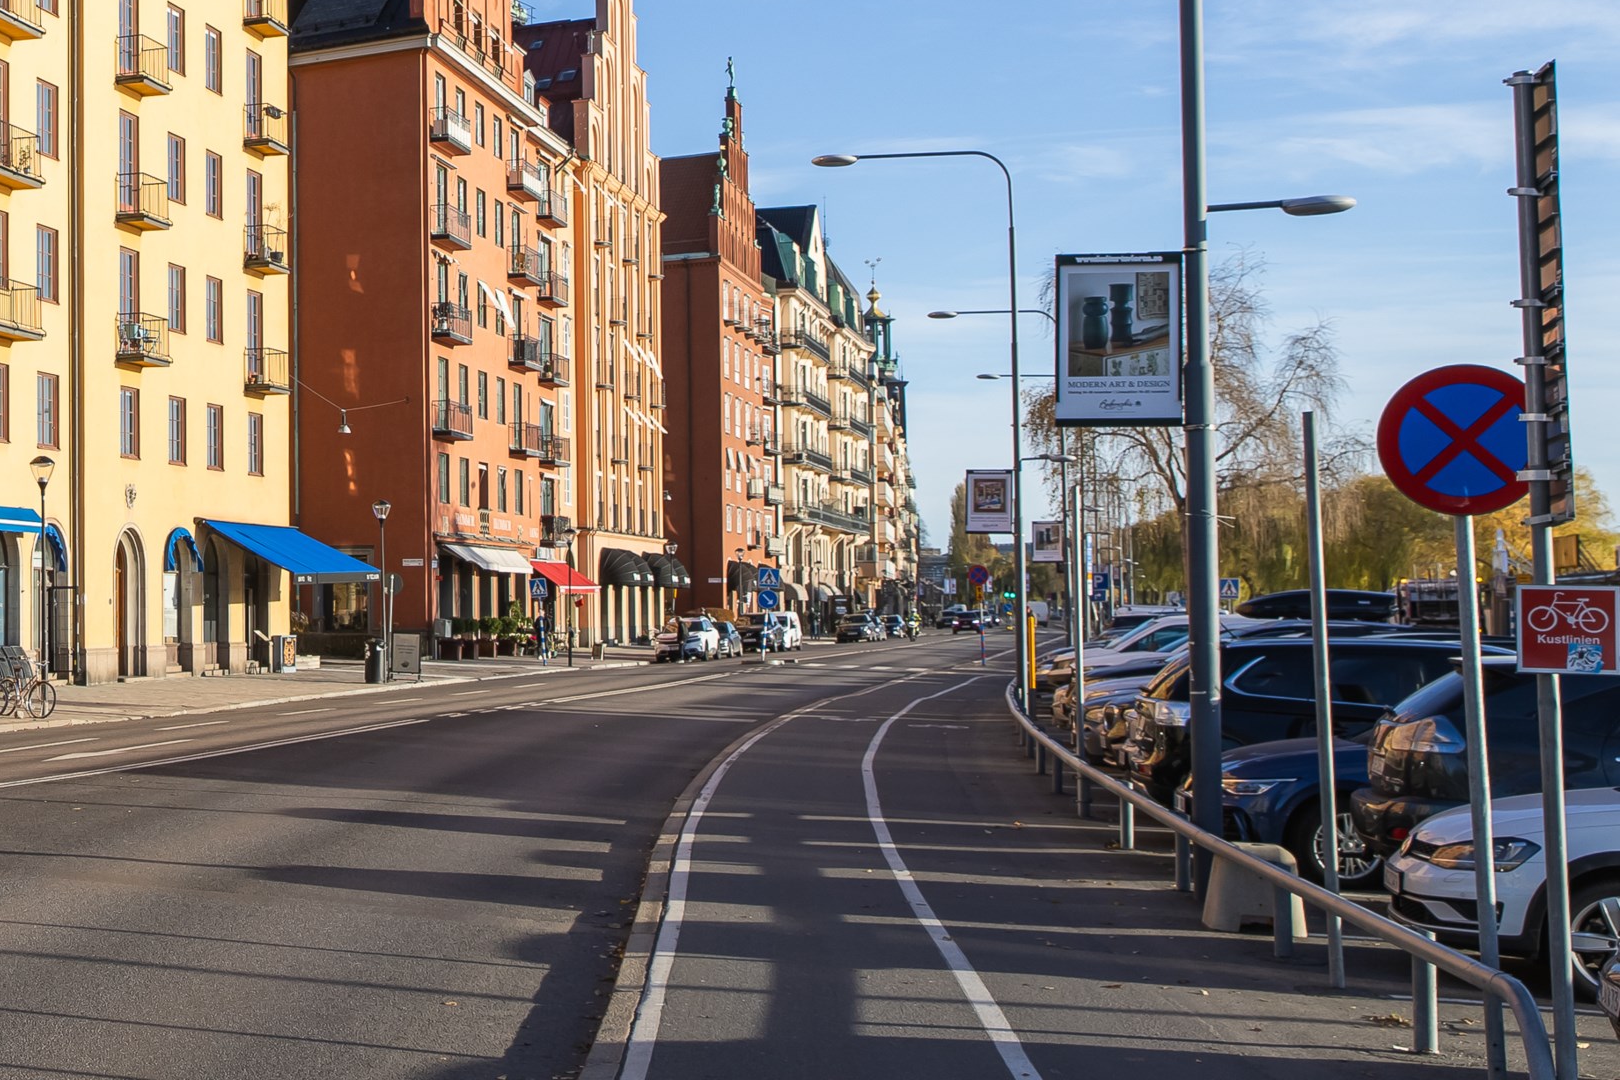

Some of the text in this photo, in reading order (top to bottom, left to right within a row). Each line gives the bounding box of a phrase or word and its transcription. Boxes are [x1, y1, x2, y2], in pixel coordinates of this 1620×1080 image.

[1128, 380, 1135, 388] &
[1137, 380, 1171, 388] DESIGN
[1094, 575, 1104, 588] P
[1537, 634, 1600, 645] Kustlinien
